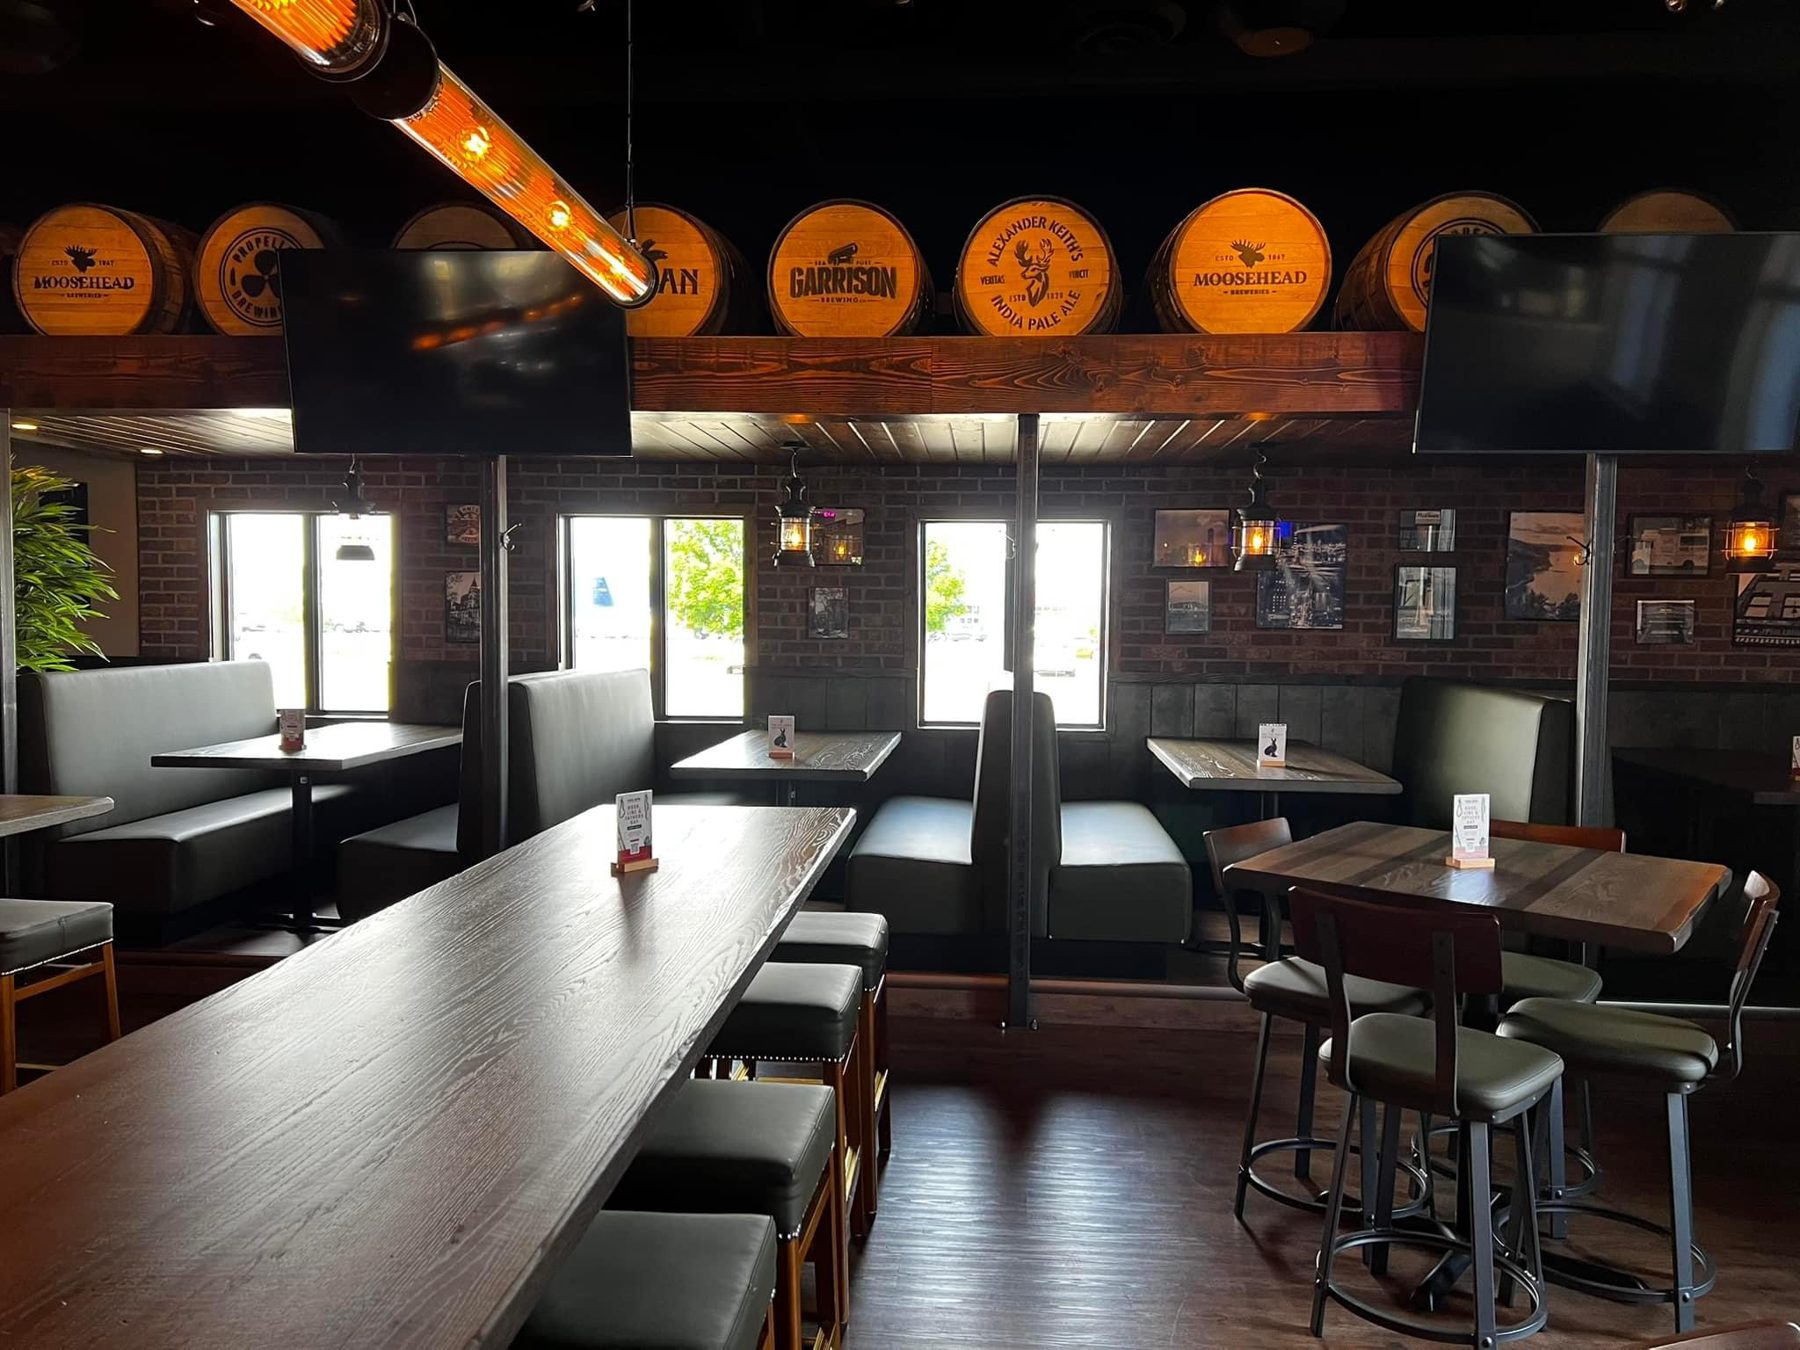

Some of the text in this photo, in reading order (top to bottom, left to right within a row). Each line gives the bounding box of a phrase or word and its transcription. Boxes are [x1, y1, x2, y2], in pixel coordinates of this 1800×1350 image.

[987, 216, 1084, 267] ALEXANDER KEITH'S
[34, 275, 135, 290] MOOSEHEAD
[790, 266, 897, 299] GARRISON
[1193, 271, 1307, 287] MOOSEHEAD
[231, 289, 282, 318] BREWIN
[991, 290, 1080, 330] INDIA PALE ALE
